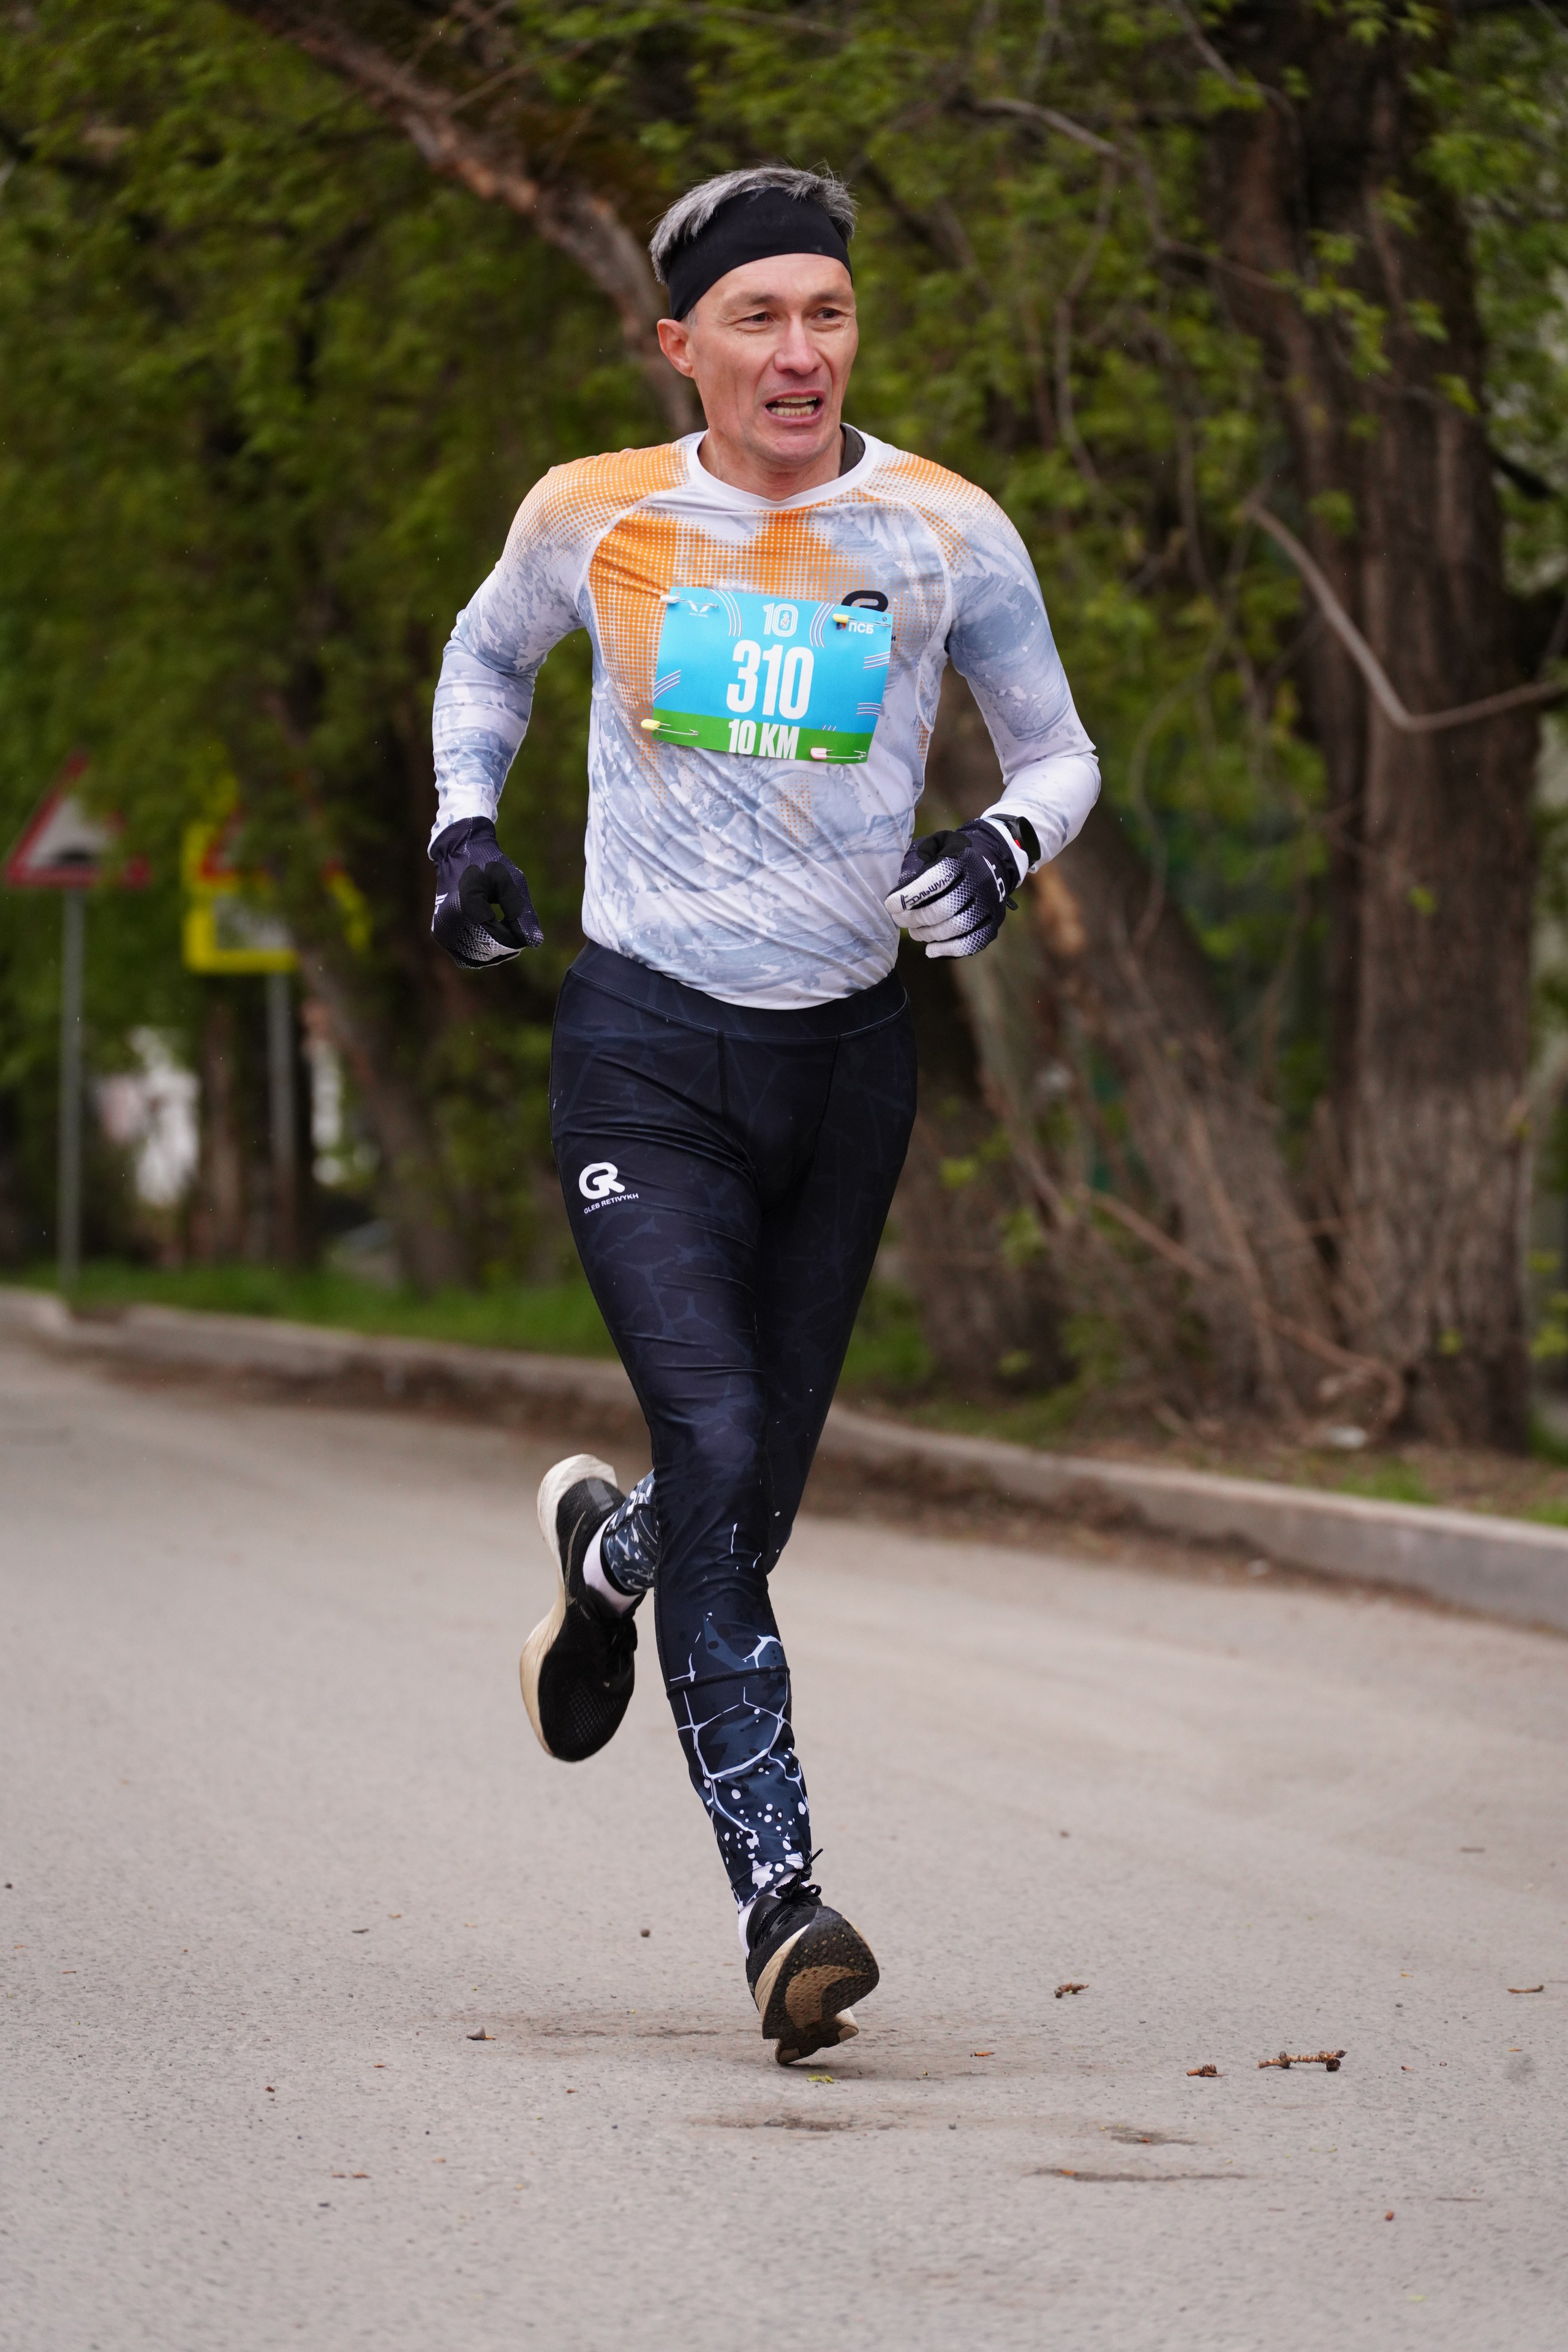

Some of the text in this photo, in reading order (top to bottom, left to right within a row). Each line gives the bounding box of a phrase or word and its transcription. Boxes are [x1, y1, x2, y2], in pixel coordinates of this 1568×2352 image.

[763, 603, 798, 637] 10
[848, 622, 874, 634] ПСБ
[726, 639, 814, 720] 310
[728, 718, 757, 755] 10
[584, 1193, 639, 1214] GLEB RETIVYKH
